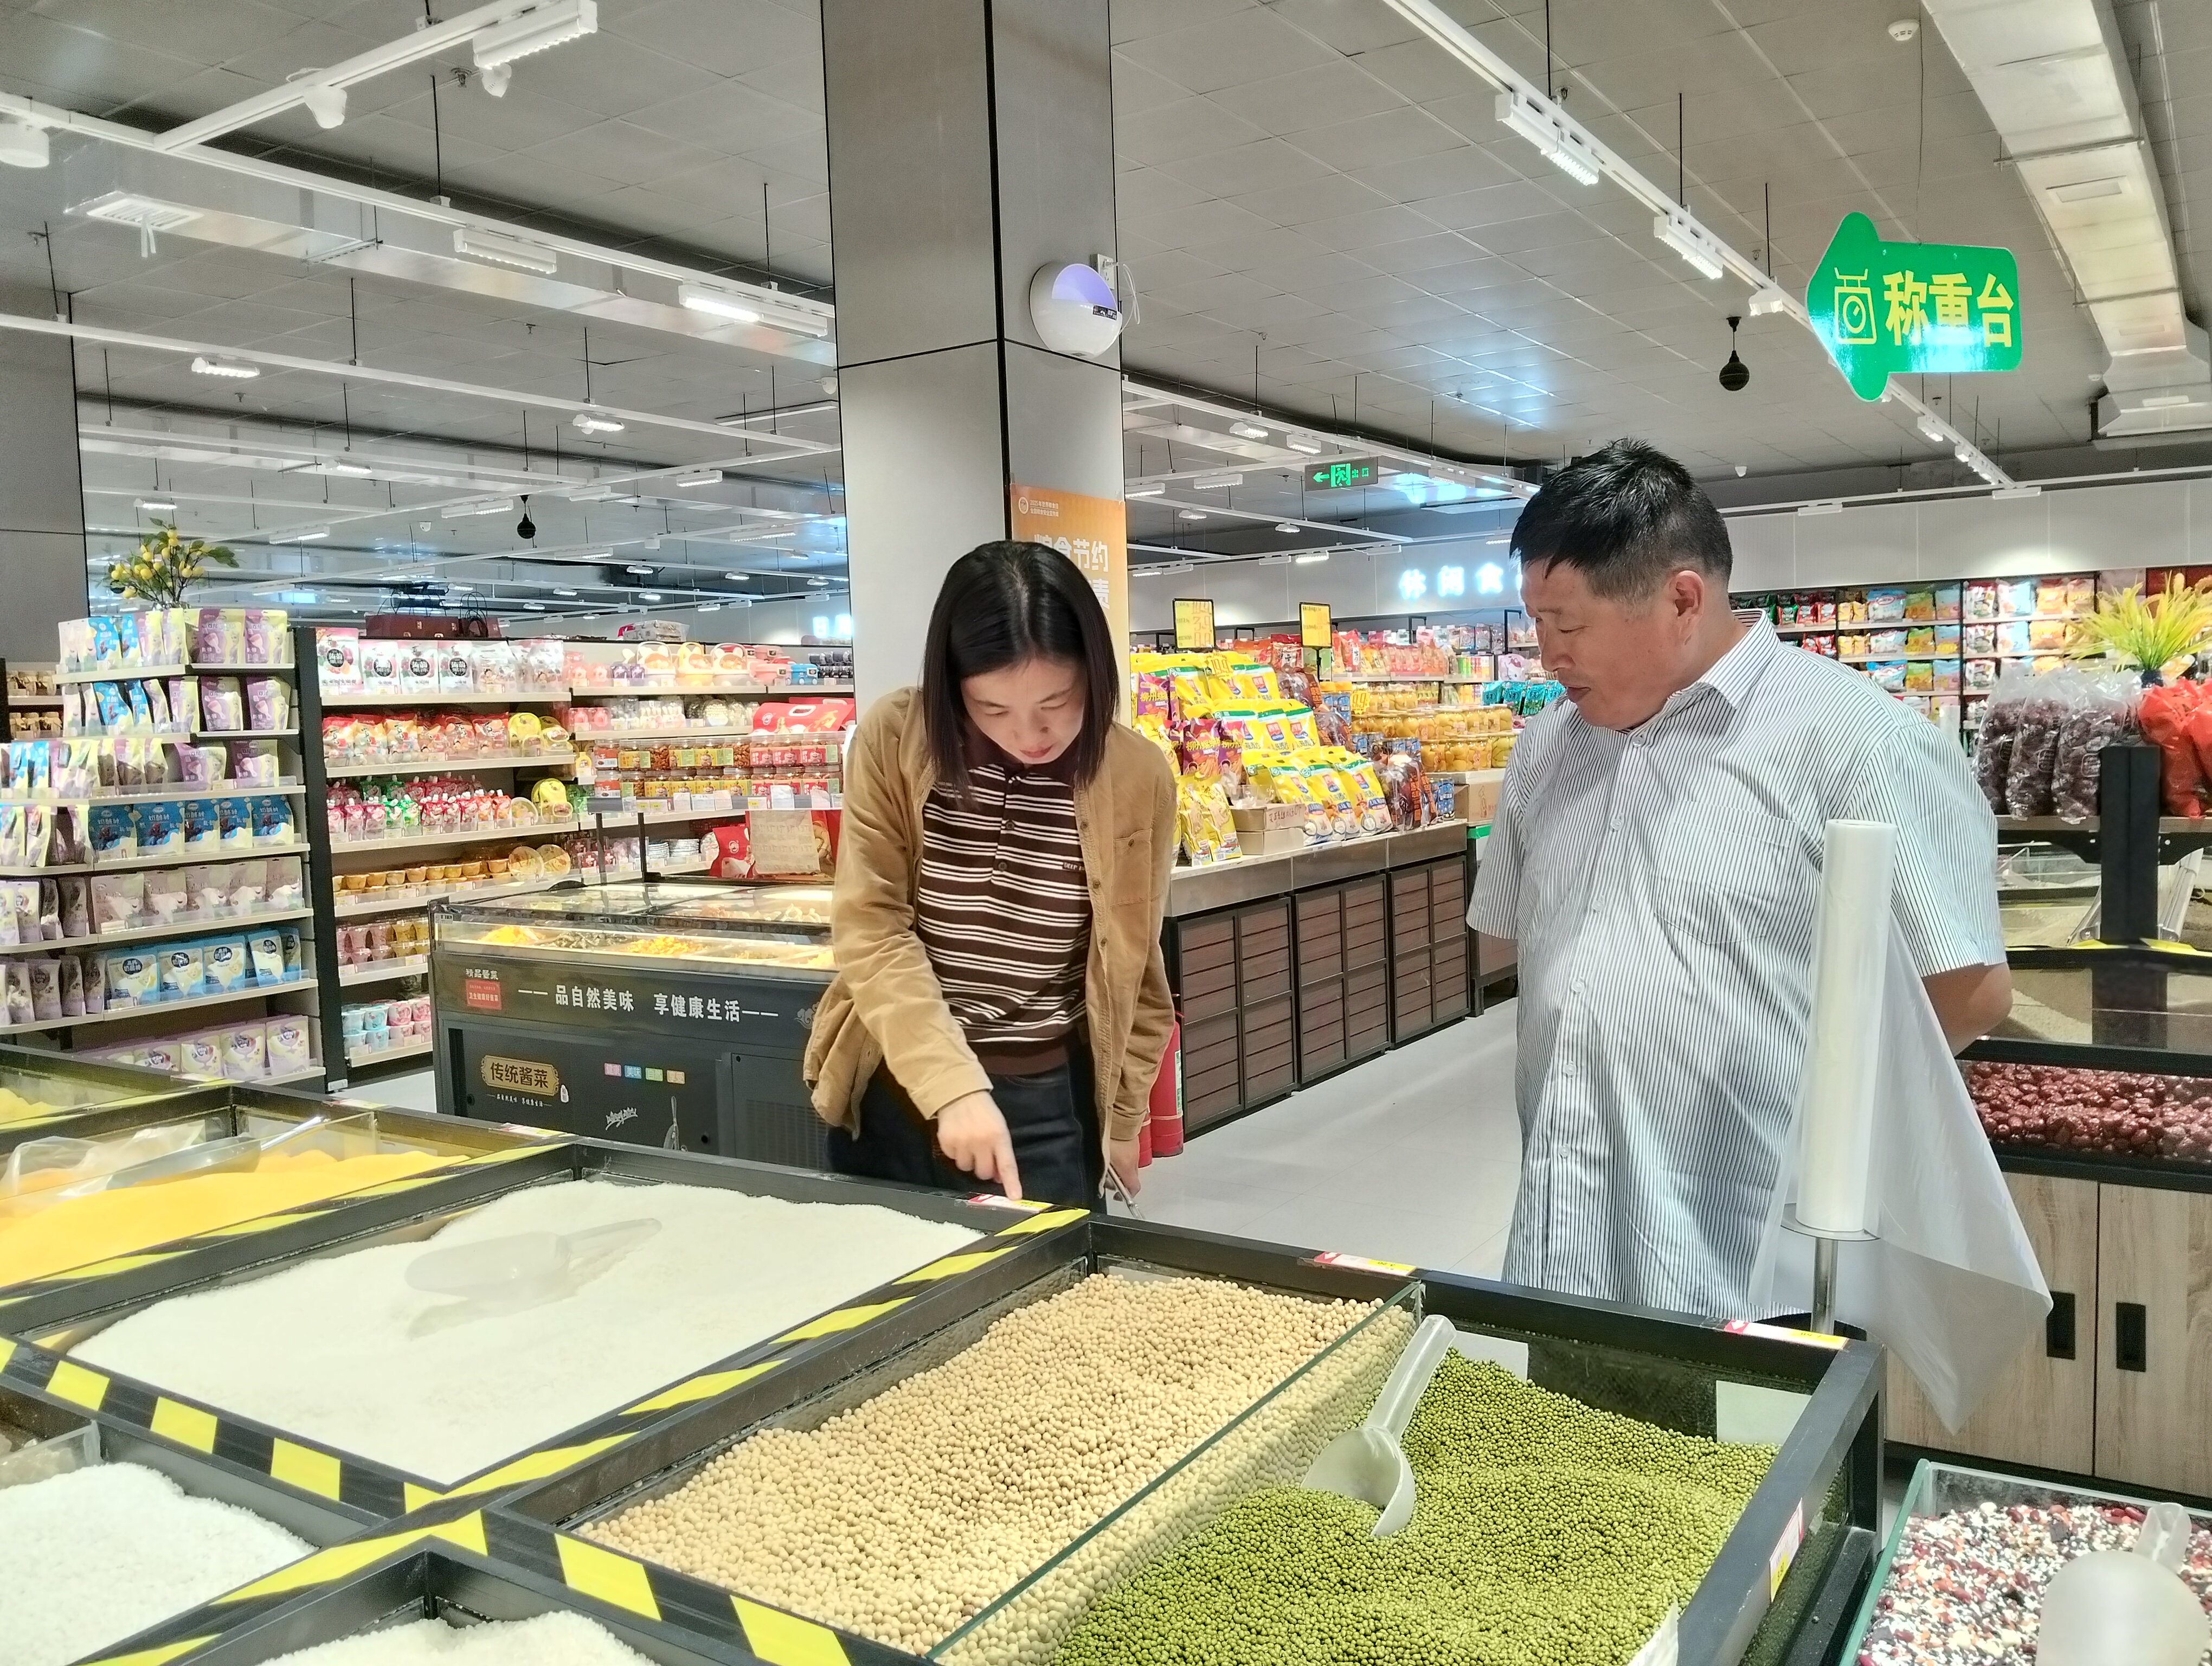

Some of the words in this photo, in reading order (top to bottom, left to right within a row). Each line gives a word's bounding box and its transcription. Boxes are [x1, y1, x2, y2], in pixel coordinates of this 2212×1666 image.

[1882, 270, 2015, 348] 称重台
[1352, 467, 1369, 478] 出口
[555, 984, 634, 1012] 品自然美味
[653, 992, 740, 1022] 享健康生活
[490, 1062, 549, 1088] 传统酱菜
[626, 1065, 641, 1078] 美味
